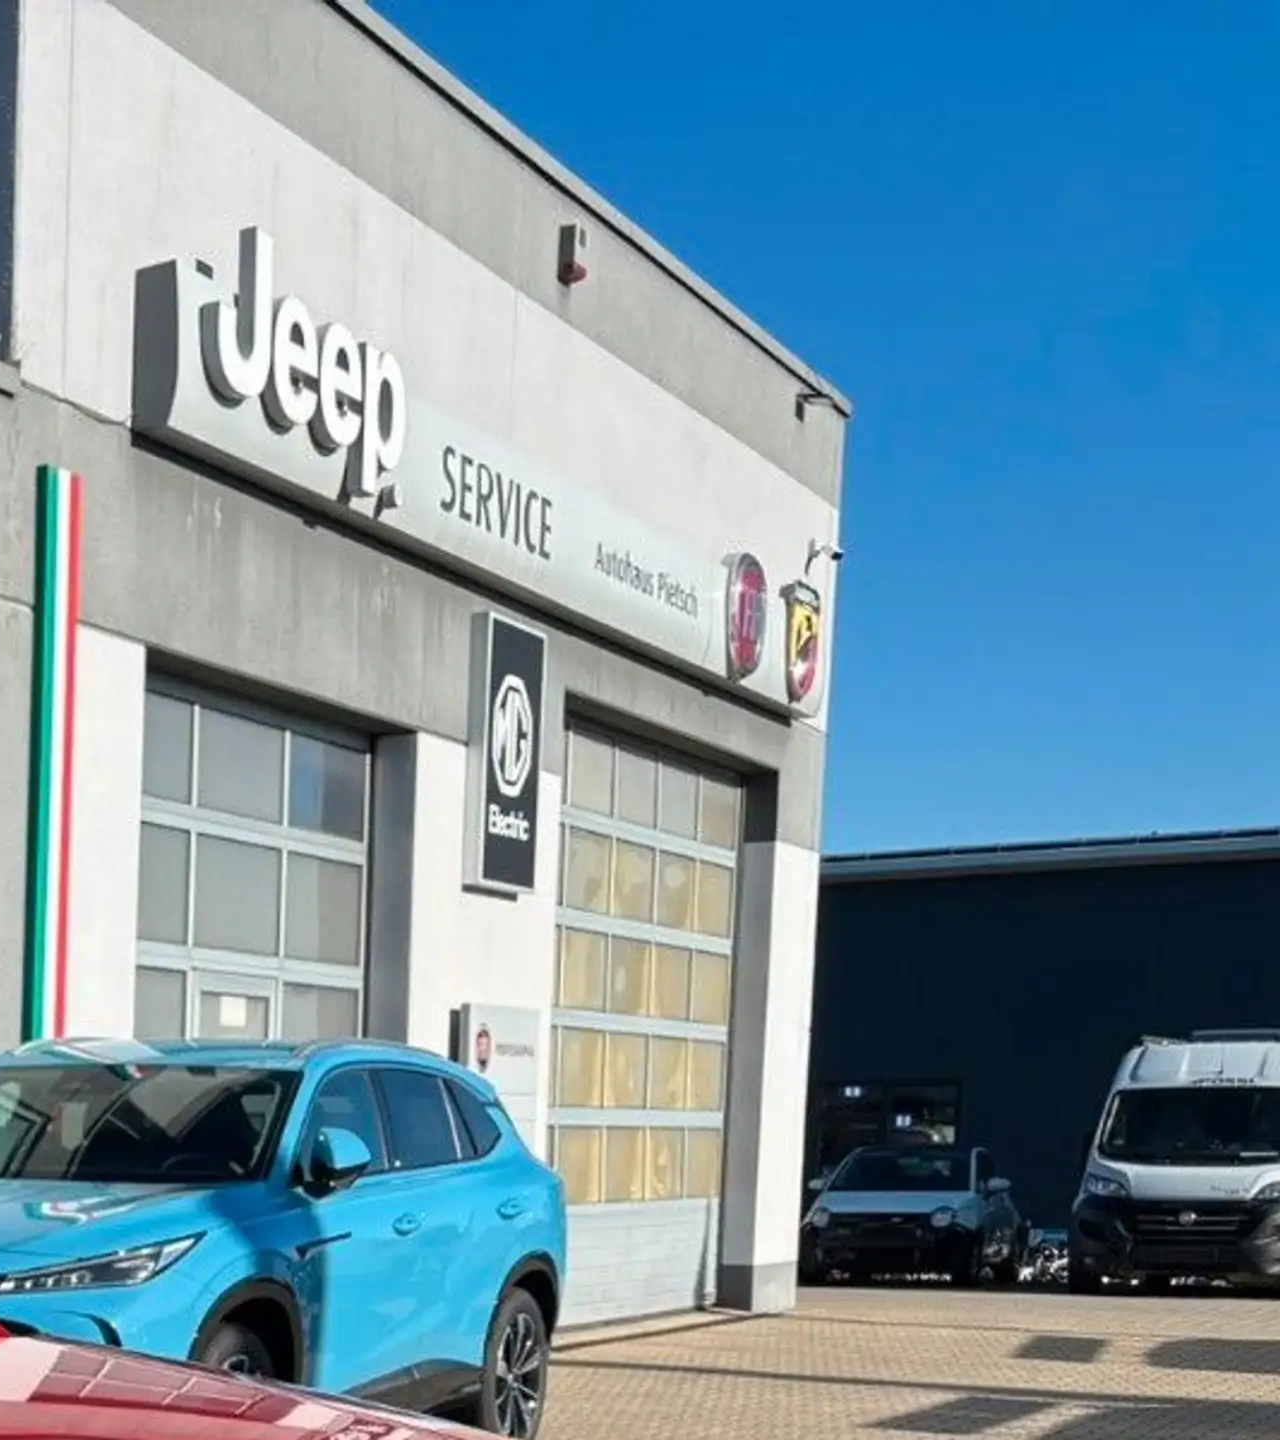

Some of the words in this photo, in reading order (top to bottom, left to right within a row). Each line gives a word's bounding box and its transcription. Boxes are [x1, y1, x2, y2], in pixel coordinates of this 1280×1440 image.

[199, 226, 406, 497] Jeep
[440, 445, 553, 560] SERVICE
[594, 542, 654, 597] Autohaus
[657, 571, 699, 619] Pietsch
[493, 687, 531, 785] MG
